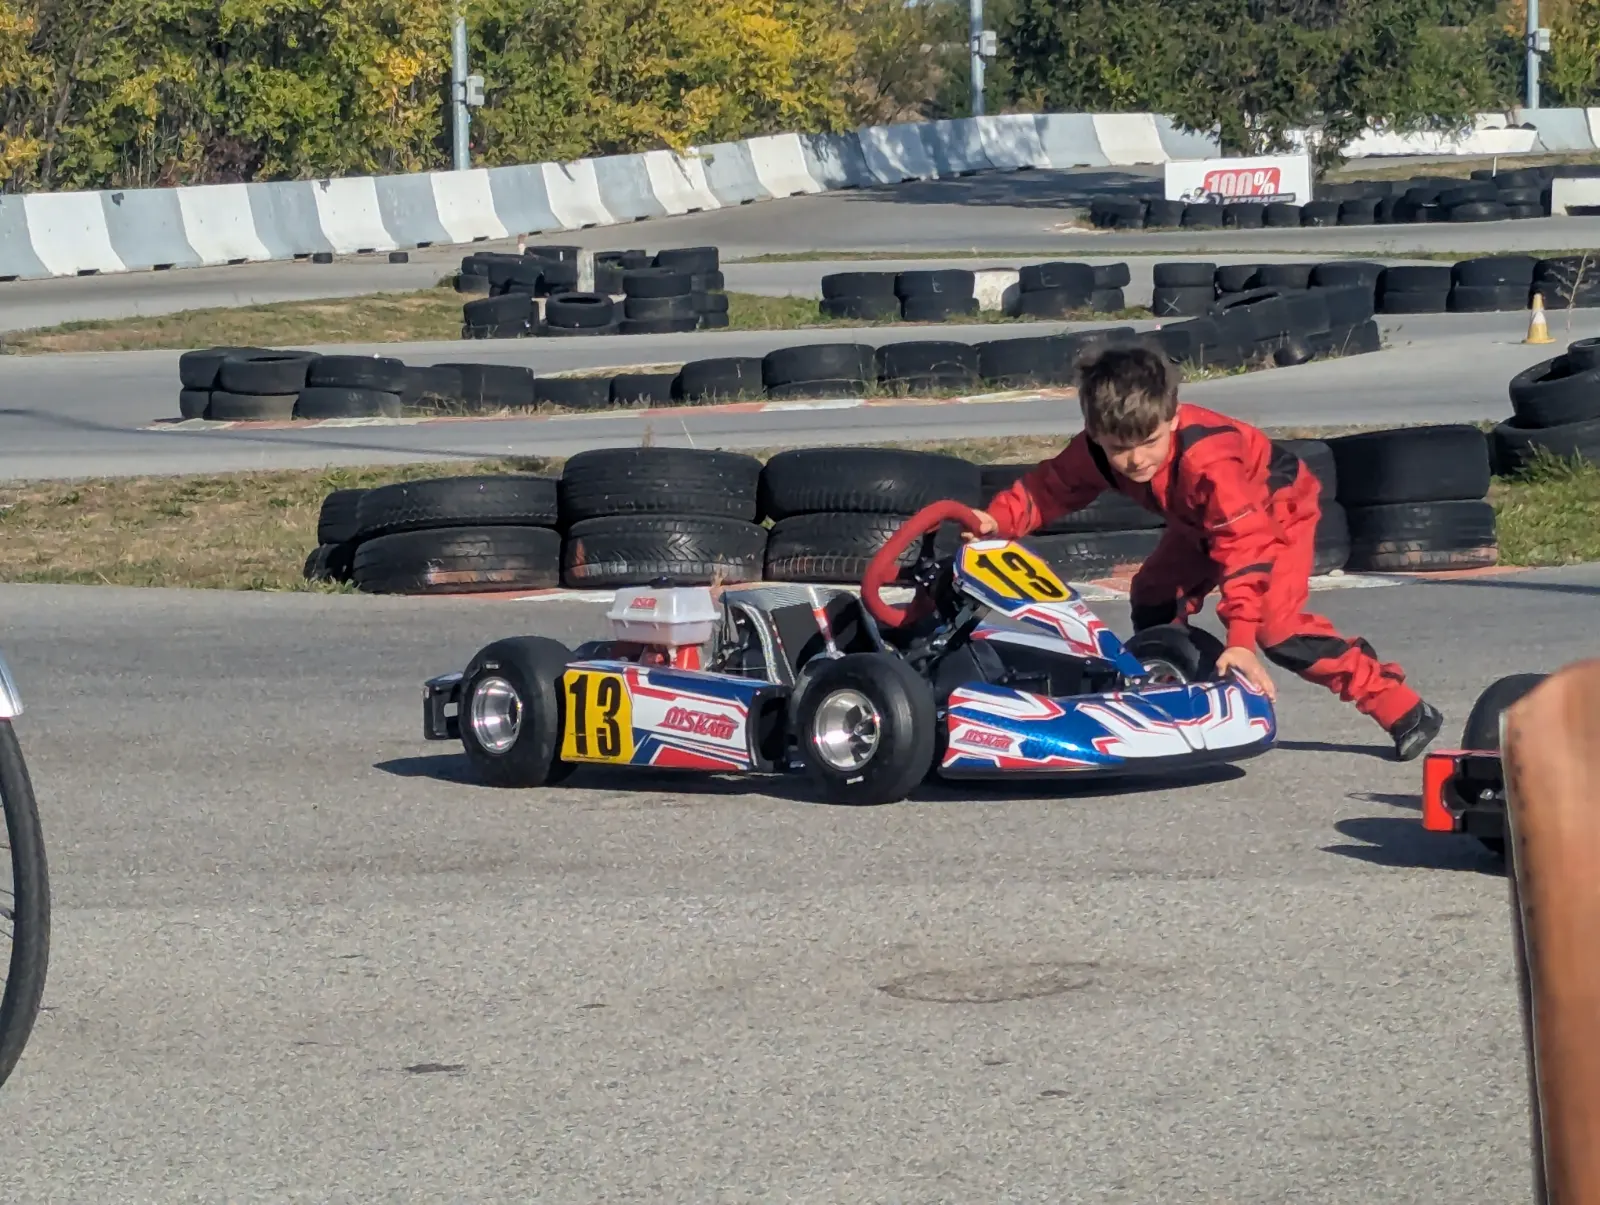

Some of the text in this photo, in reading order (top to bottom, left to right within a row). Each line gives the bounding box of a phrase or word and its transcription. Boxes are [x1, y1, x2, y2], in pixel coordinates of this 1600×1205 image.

[1208, 170, 1275, 197] 100%
[975, 551, 1064, 601] 13
[569, 674, 622, 757] 13
